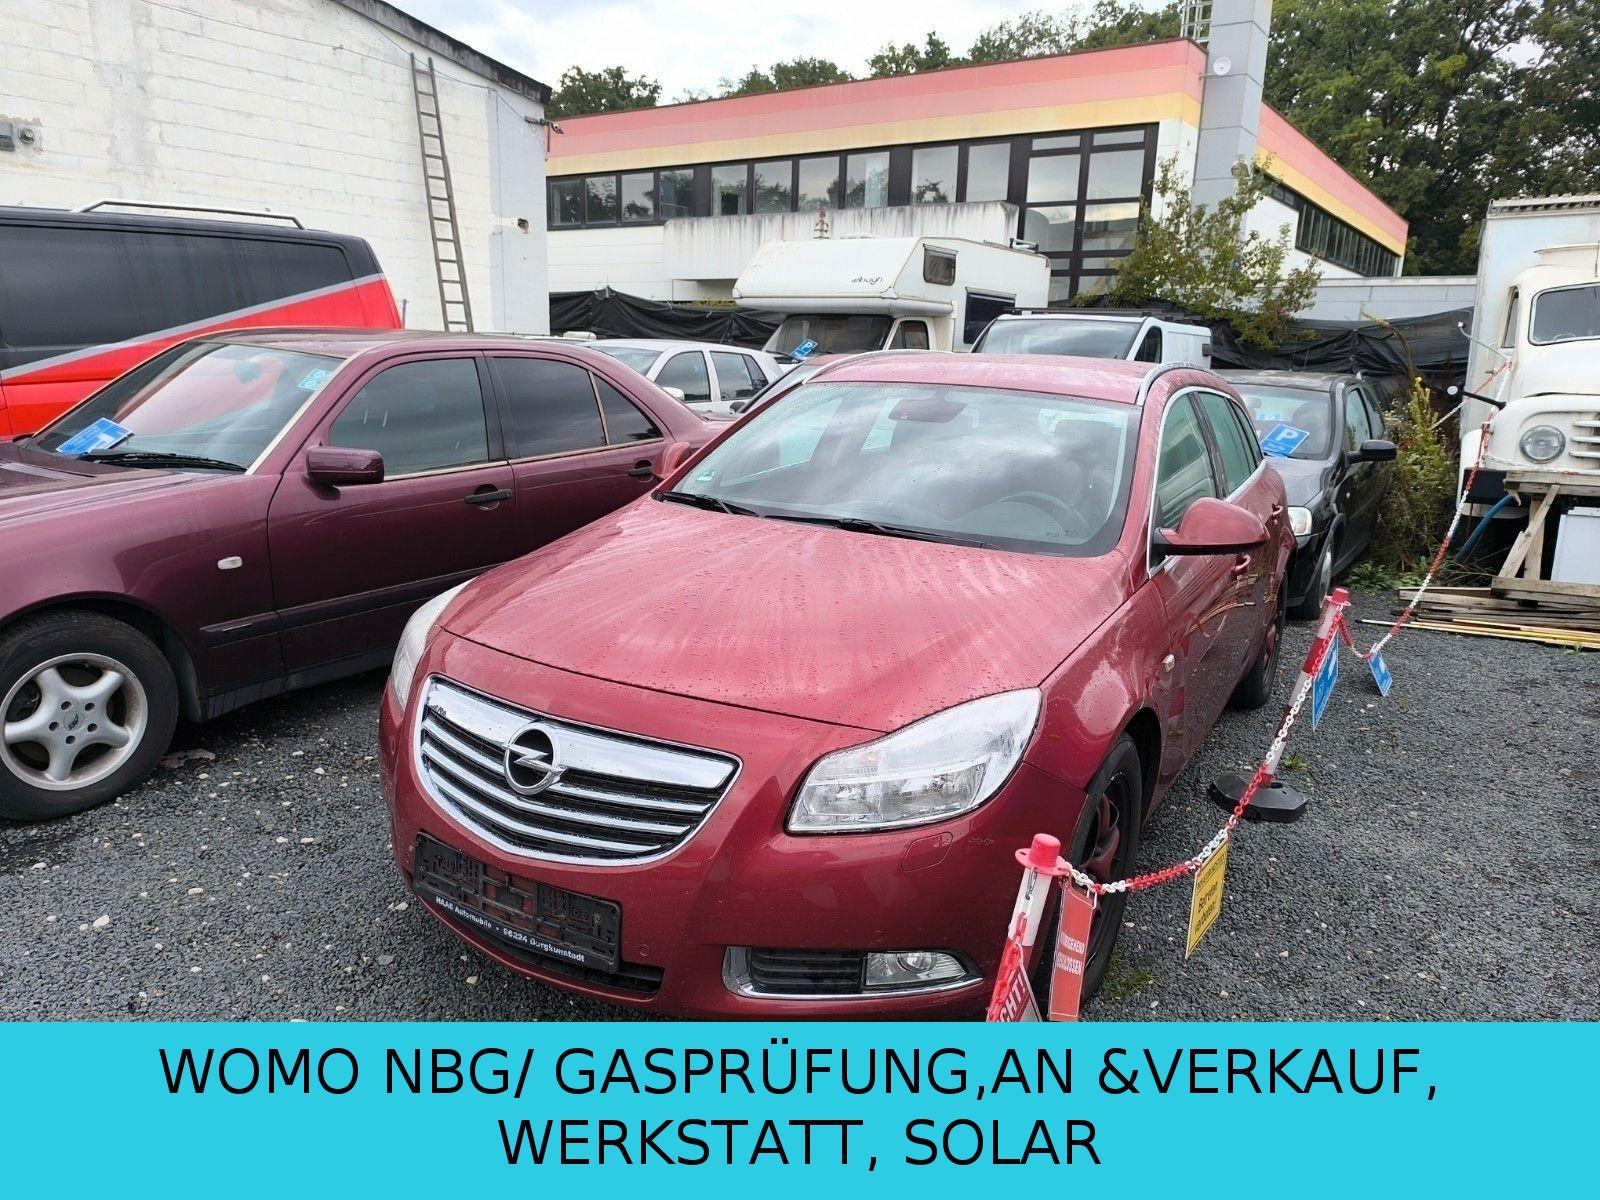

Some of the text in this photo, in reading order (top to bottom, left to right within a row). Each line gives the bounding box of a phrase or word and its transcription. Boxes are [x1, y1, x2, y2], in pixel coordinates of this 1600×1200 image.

[1275, 428, 1299, 441] P
[435, 895, 454, 911] HAAS
[454, 905, 492, 930] Automobile
